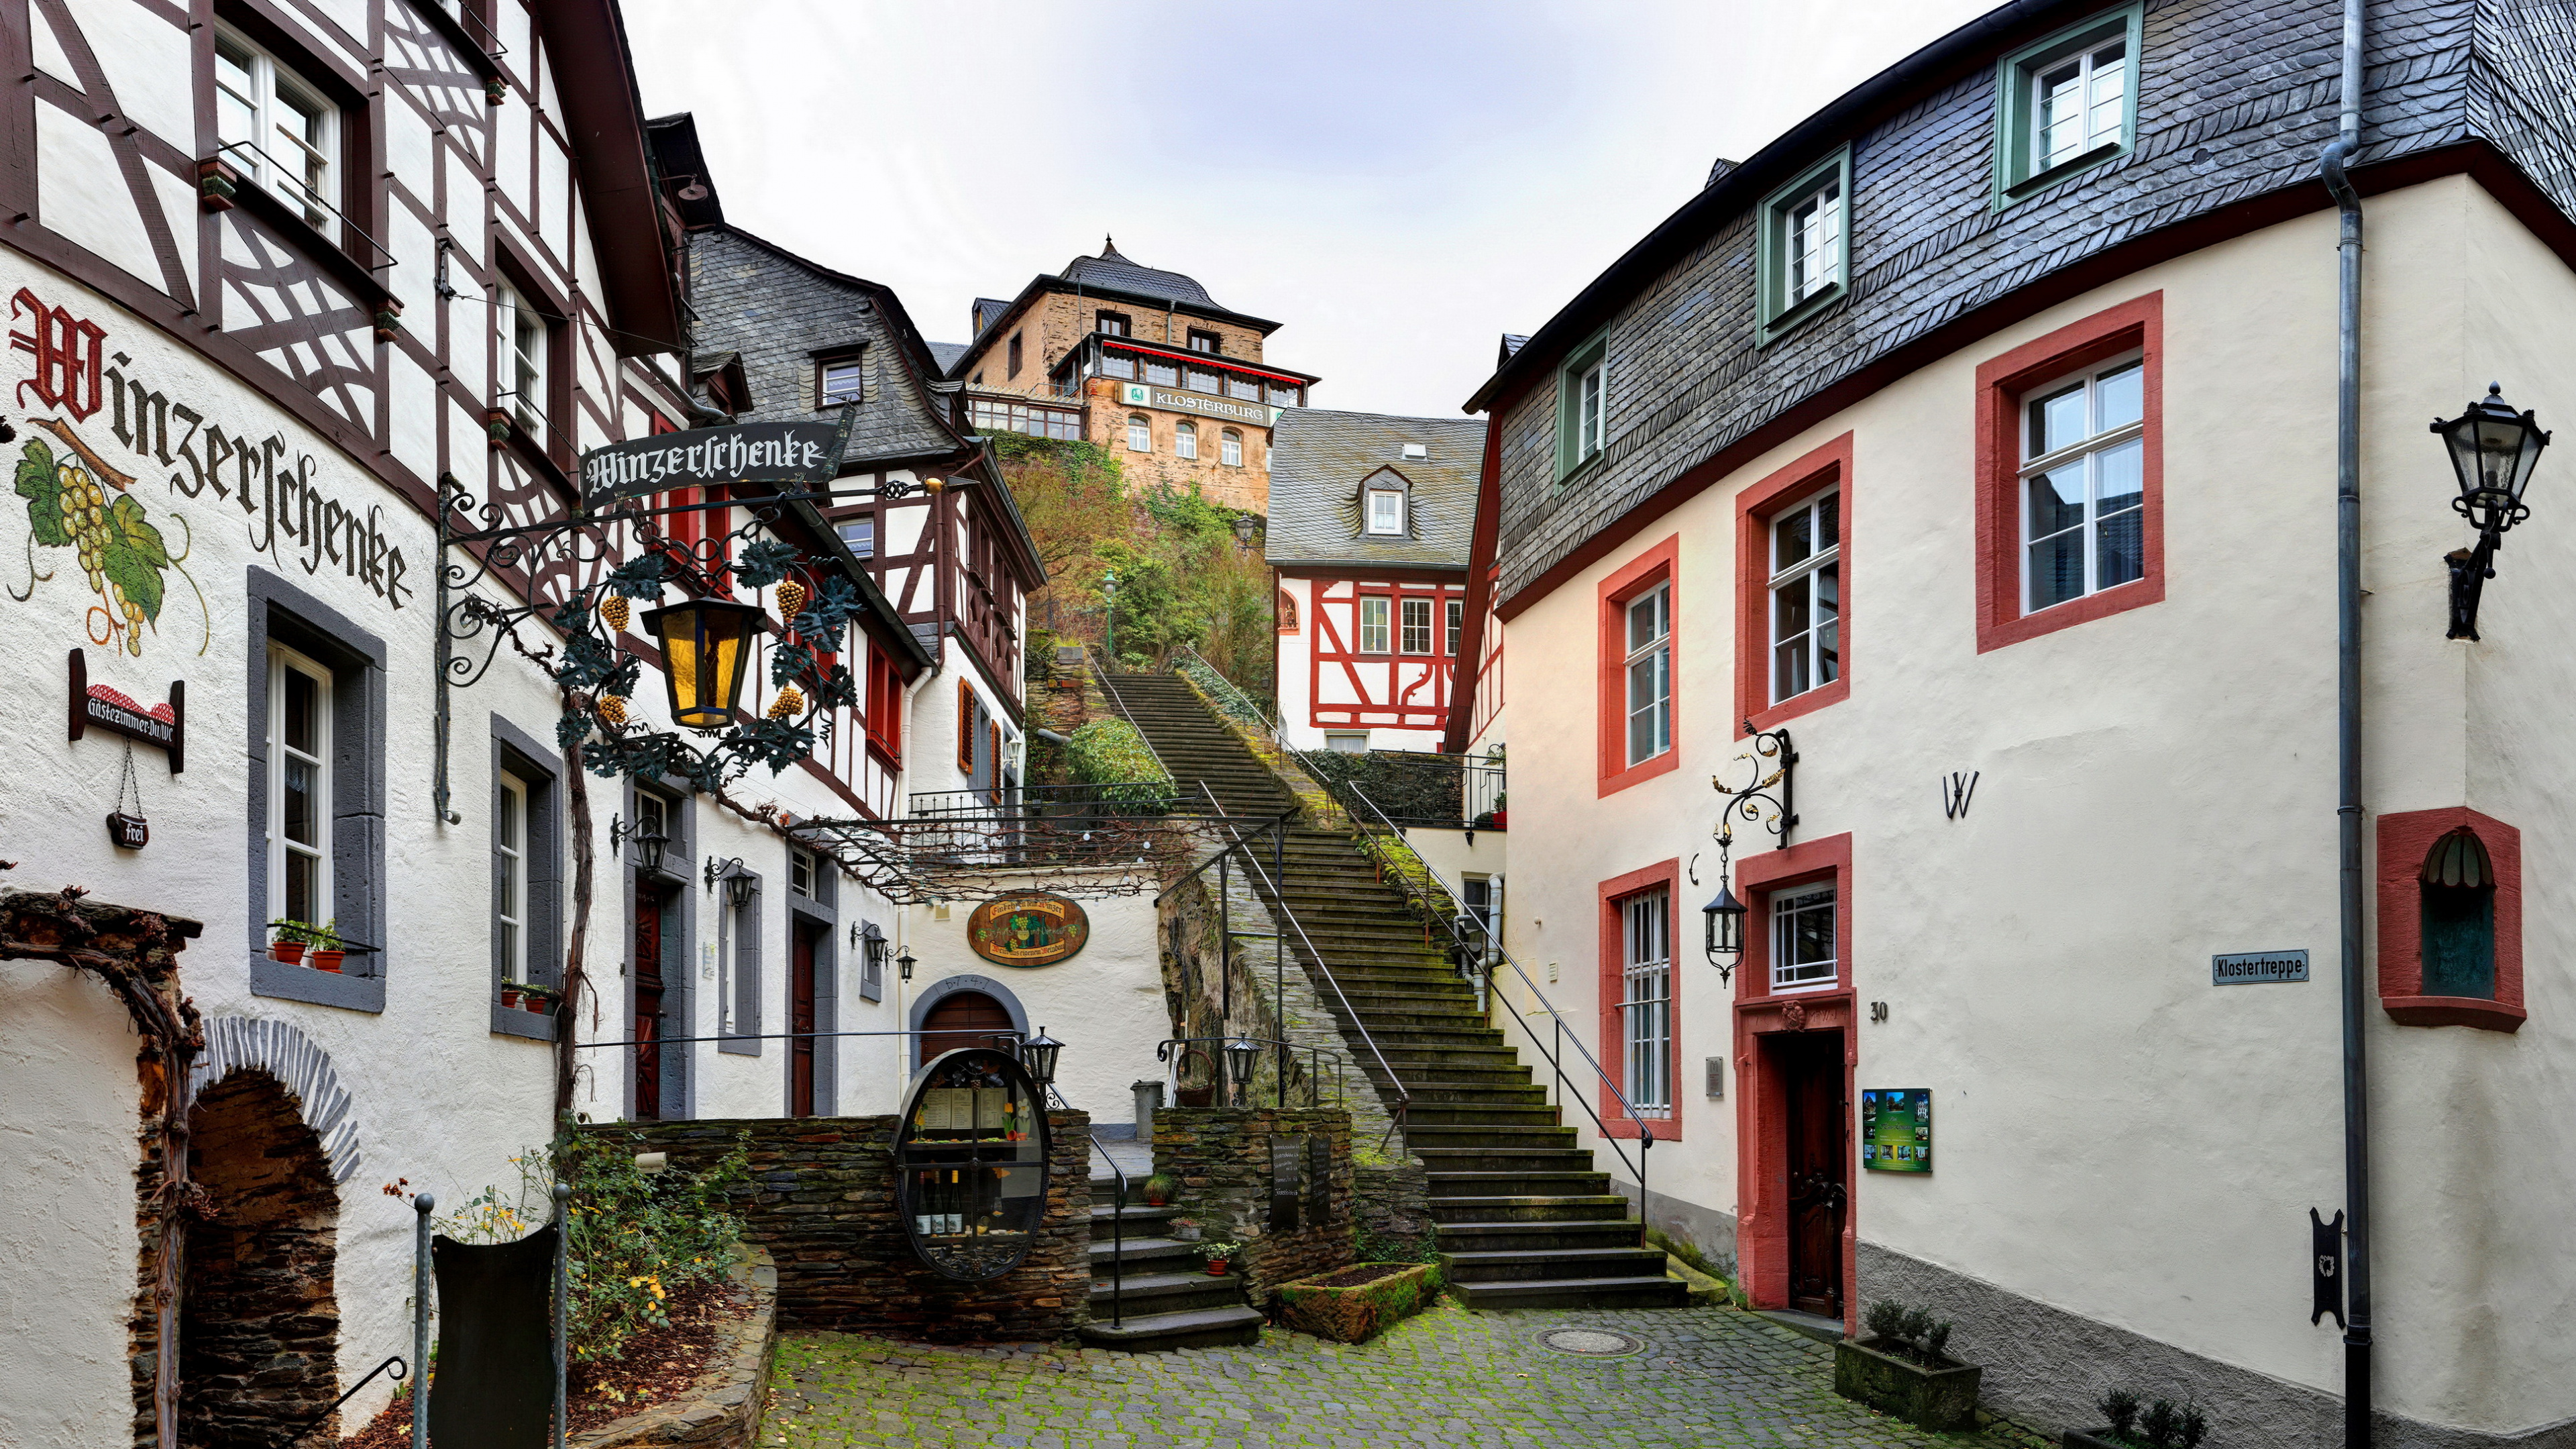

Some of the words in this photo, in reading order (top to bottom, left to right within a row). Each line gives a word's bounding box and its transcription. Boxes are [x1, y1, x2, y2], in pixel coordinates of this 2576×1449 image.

[1155, 392, 1264, 420] KLOSTERBURG
[125, 822, 144, 843] frei
[2218, 957, 2302, 979] Klostertreppe
[1870, 1002, 1888, 1022] 30
